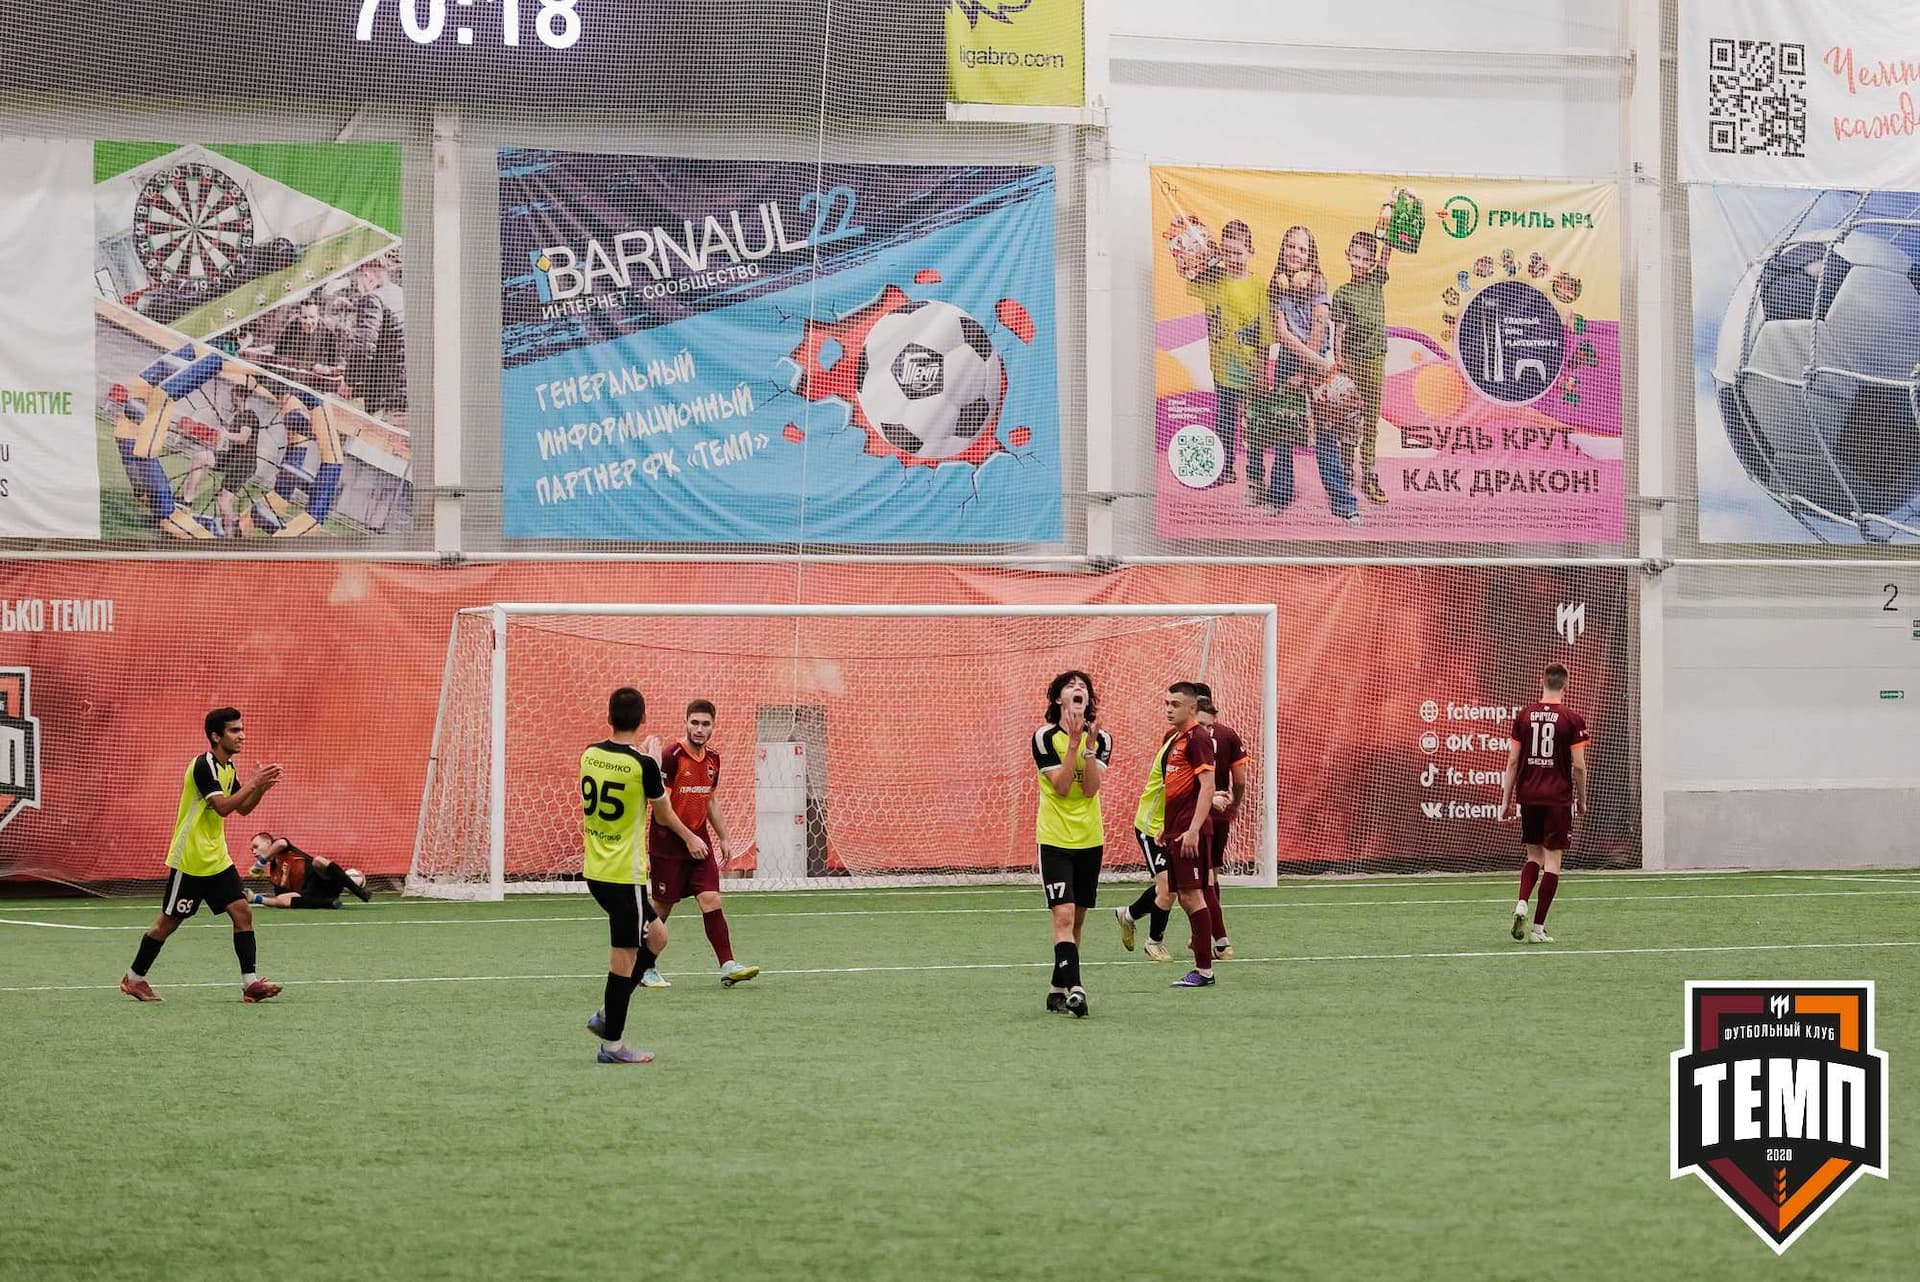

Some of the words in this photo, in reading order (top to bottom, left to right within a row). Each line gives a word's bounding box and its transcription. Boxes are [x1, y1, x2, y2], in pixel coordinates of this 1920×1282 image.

[959, 45, 1064, 68] ligabro.com
[1488, 209, 1555, 229] ГРИЛЬ
[1561, 212, 1595, 229] №1
[541, 289, 629, 321] ИНТЕРНЕТ
[642, 262, 760, 300] СООБЩЕСТВО
[536, 348, 696, 412] ГЕНЕРАЛЬНЫЙ
[1, 390, 73, 415] РИЯТИЕ
[536, 381, 755, 461] ИНФОРМАЦИОННЫЙ
[1400, 425, 1494, 455] БУДЬ
[1503, 427, 1581, 456] КРУТ,
[536, 458, 637, 506] ПАРТНЕР
[642, 448, 681, 480] ФК
[687, 430, 770, 470] «ТЕМП»
[1402, 468, 1462, 492] КАК
[1469, 468, 1600, 497] ДРАКОН!
[1883, 583, 1899, 611] 2
[50, 599, 113, 632] ТЕМП!
[1447, 733, 1474, 751] ФК
[1530, 722, 1555, 757] 18
[582, 775, 625, 822] 95
[1046, 882, 1066, 899] 17
